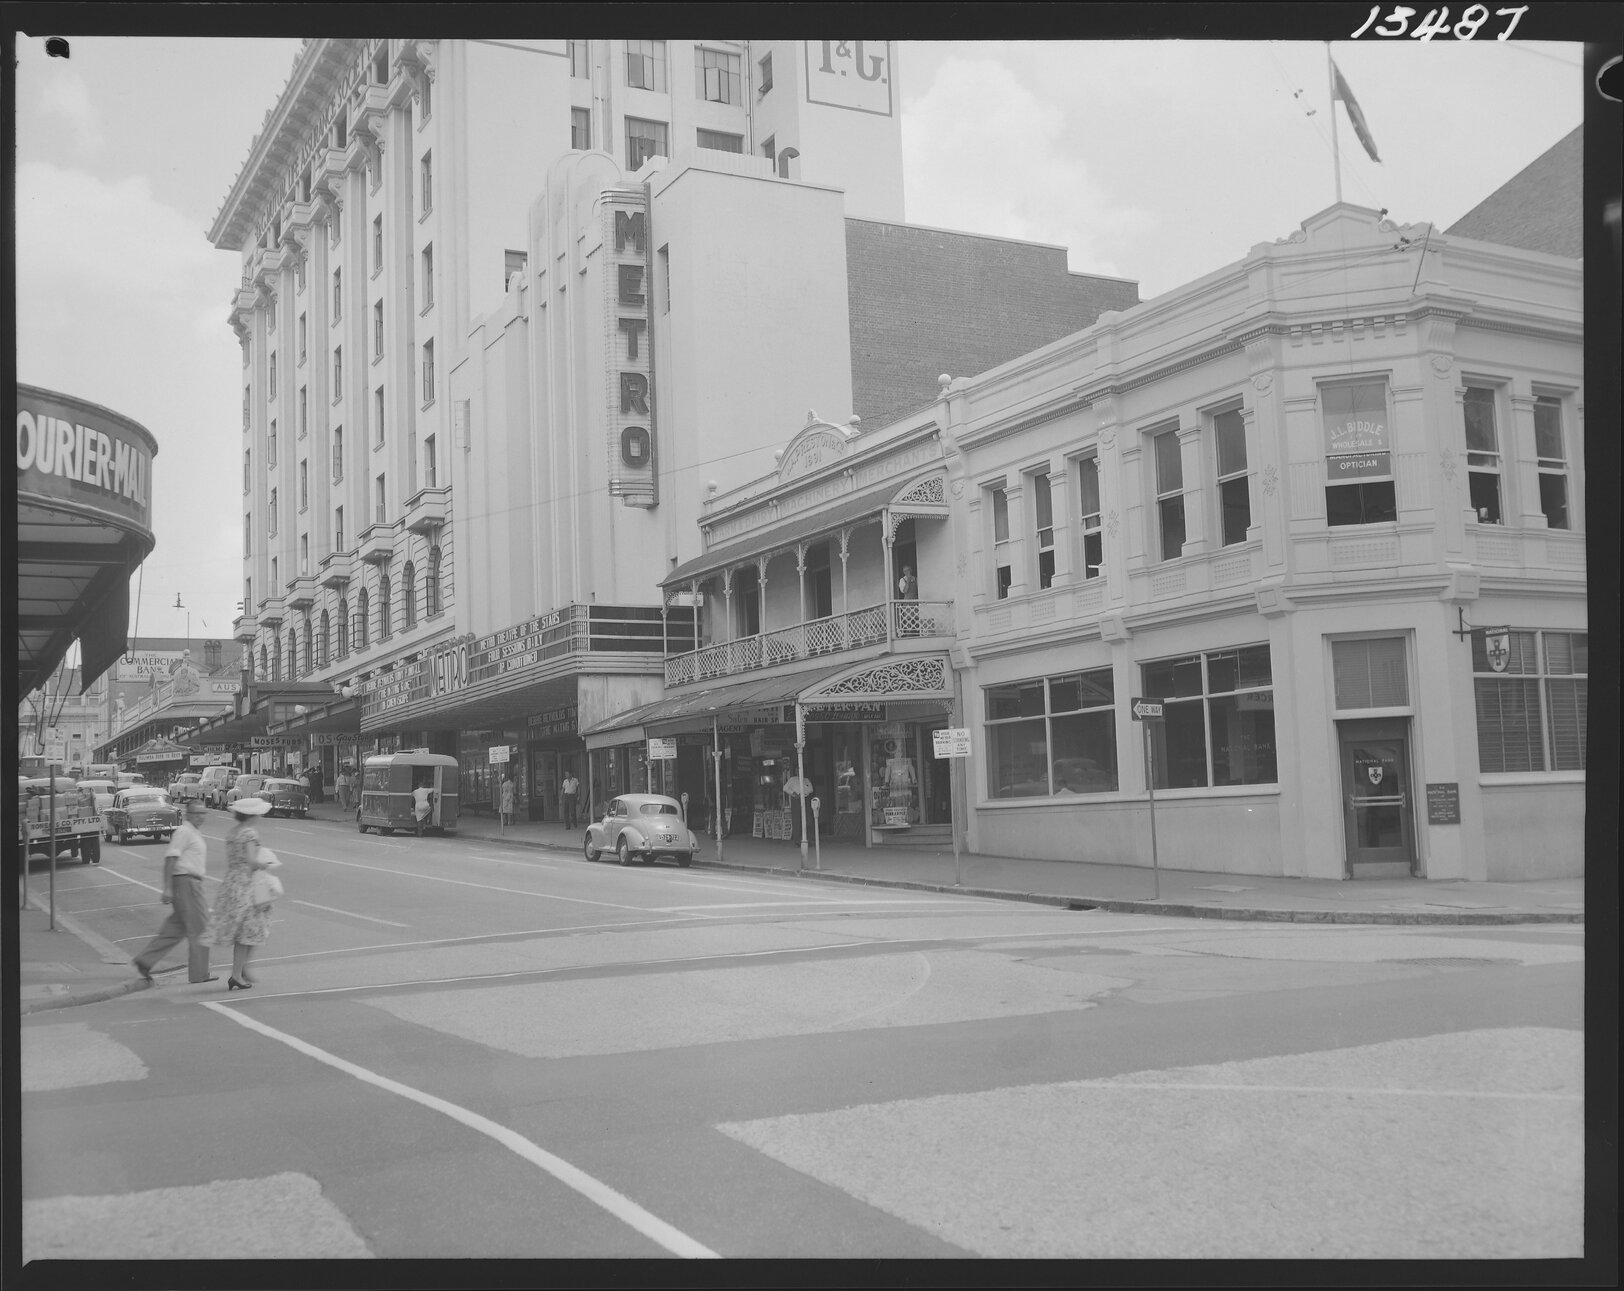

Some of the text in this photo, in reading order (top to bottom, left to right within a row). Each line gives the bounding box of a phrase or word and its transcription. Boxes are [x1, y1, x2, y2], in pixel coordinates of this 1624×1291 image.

[614, 210, 650, 470] METRO
[1347, 421, 1384, 436] BIDDLE
[1332, 439, 1373, 449] WHOLESALE
[1340, 459, 1378, 470] OPTICIAN
[781, 477, 850, 517] MACHINERY
[856, 444, 937, 486] MERCHANTS
[480, 635, 496, 651] METRO
[519, 624, 527, 636] OF
[529, 619, 540, 633] THE
[541, 611, 560, 629] STARS
[488, 648, 501, 663] FOUR
[501, 640, 526, 658] SESSIONS
[120, 657, 176, 666] COMMERCIA
[429, 644, 468, 698] METRO
[854, 701, 881, 711] PAN
[1137, 705, 1161, 714] ONE WAY
[254, 737, 280, 745] MOSES
[1254, 743, 1271, 752] BANK
